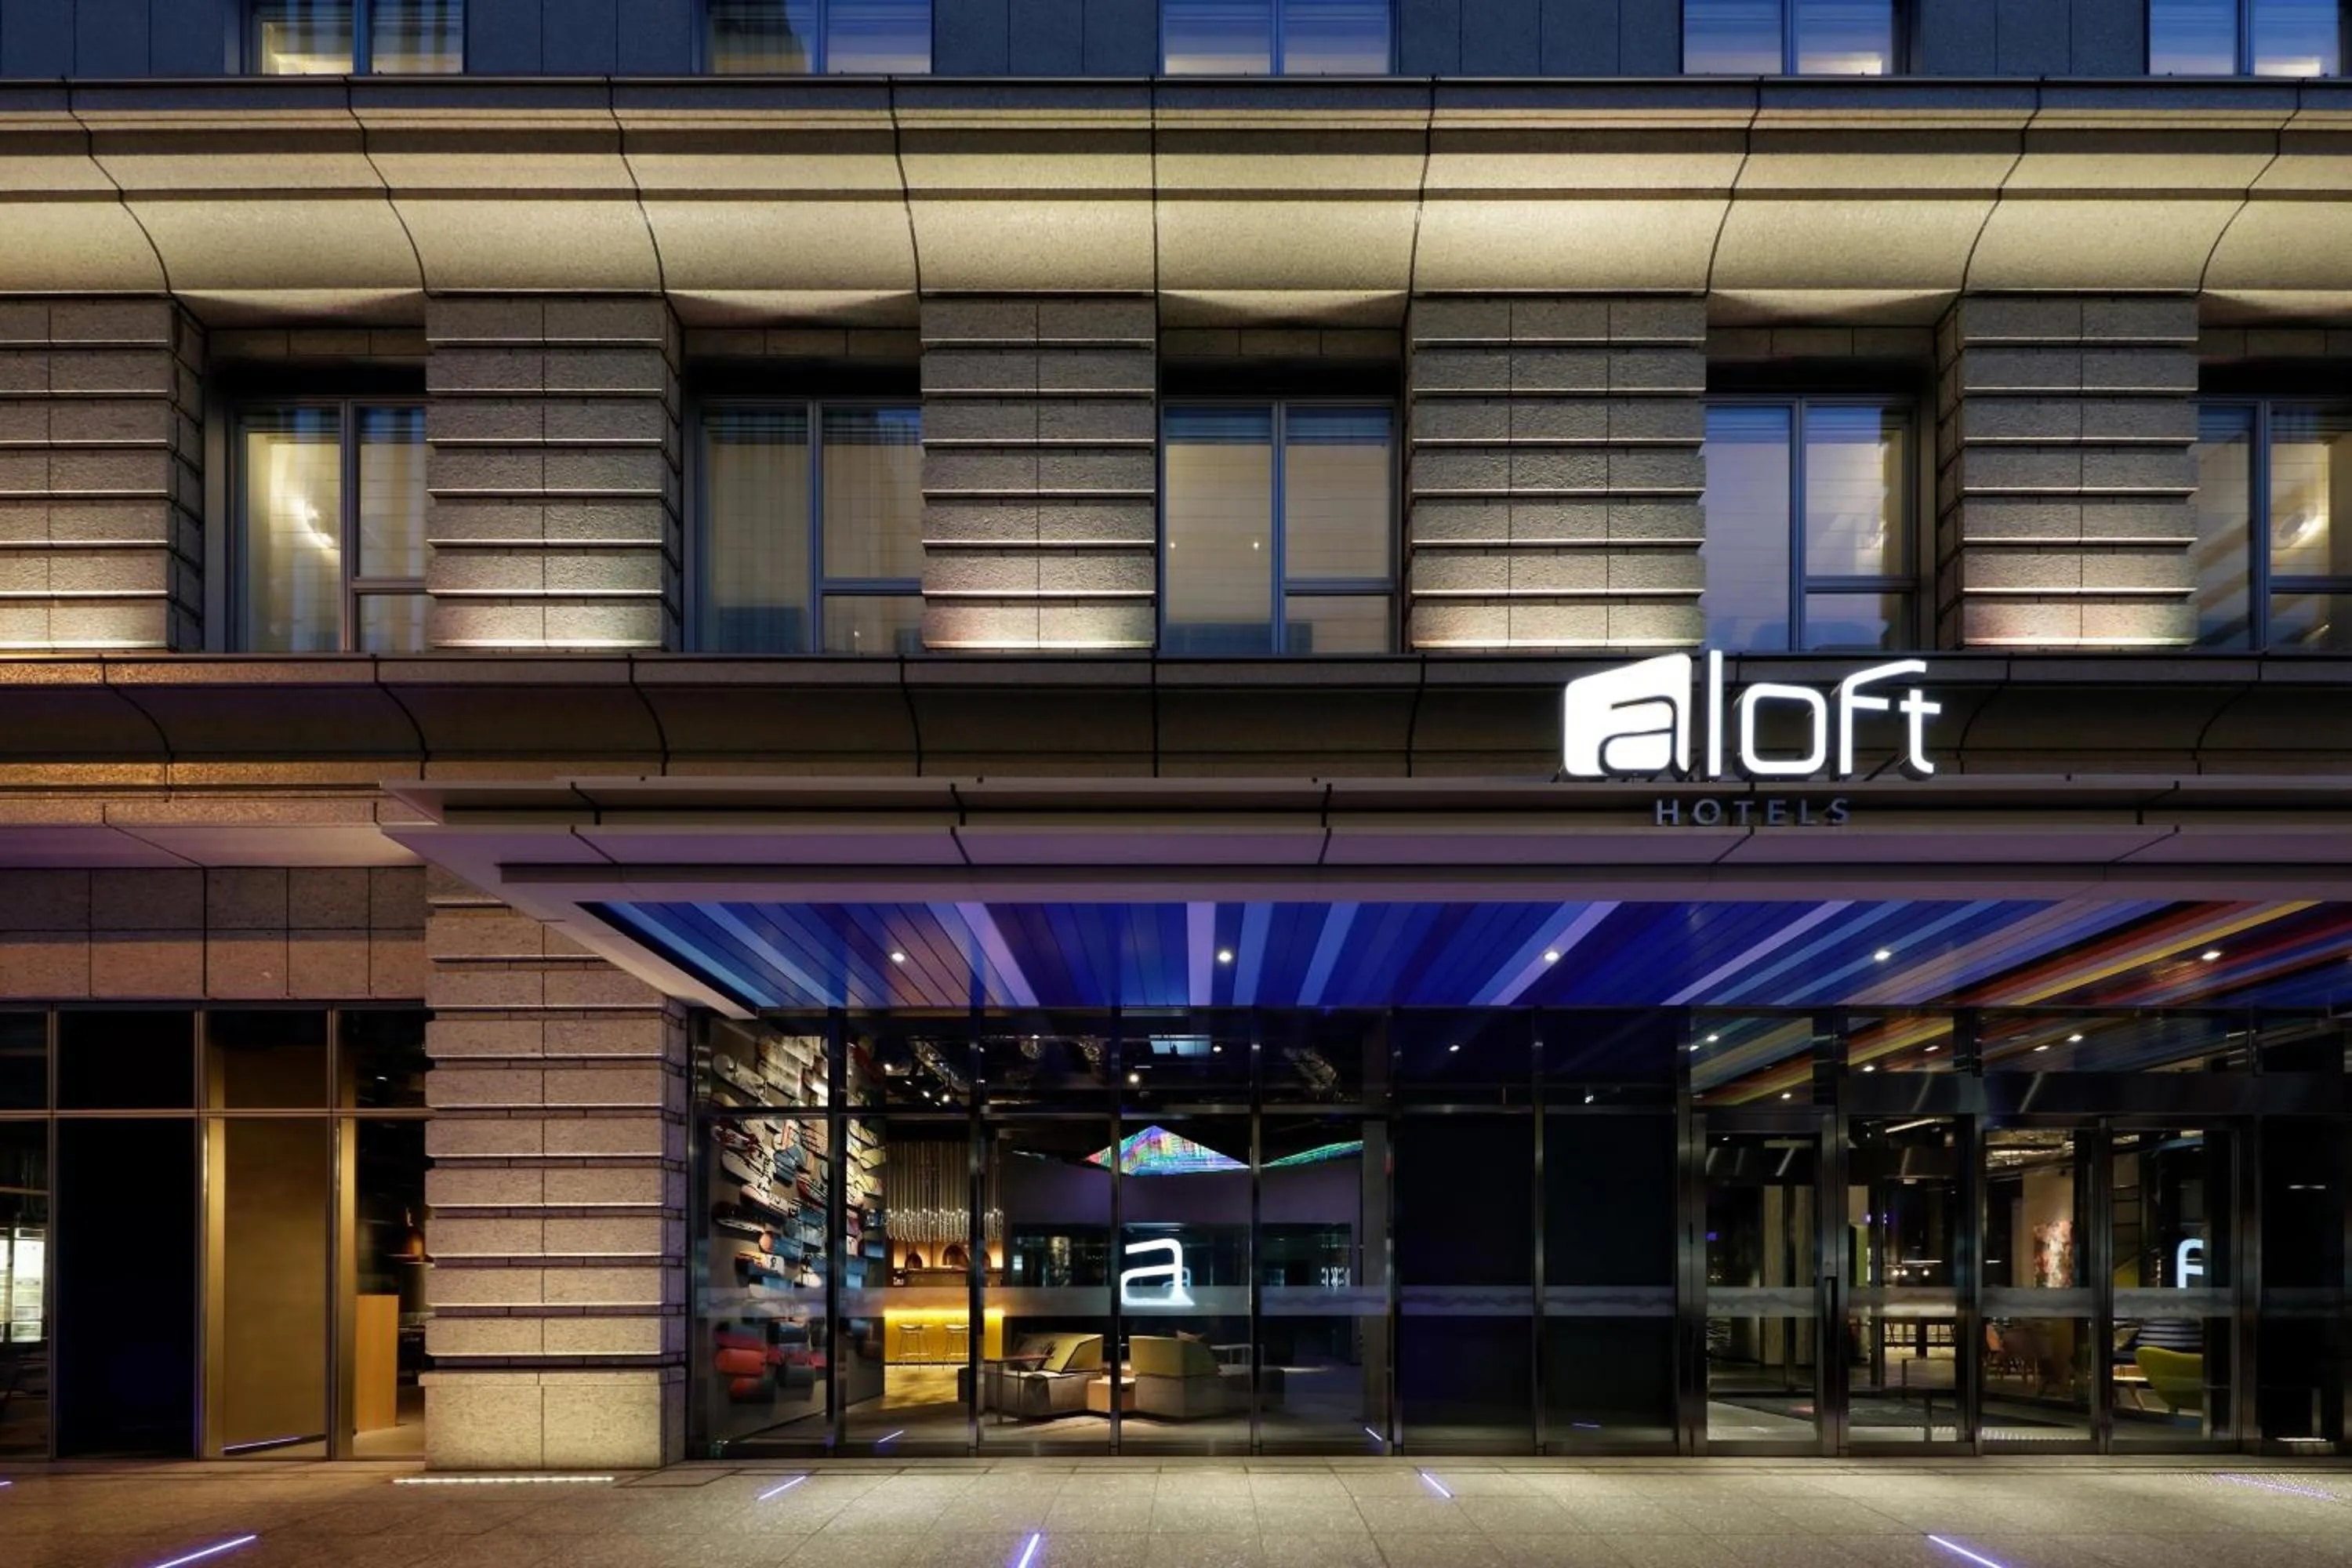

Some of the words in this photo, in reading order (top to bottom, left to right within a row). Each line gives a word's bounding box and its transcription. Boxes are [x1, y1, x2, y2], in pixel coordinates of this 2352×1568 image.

[1563, 649, 1941, 777] aloft
[1656, 798, 1850, 826] HOTELS
[1120, 1238, 1196, 1307] a
